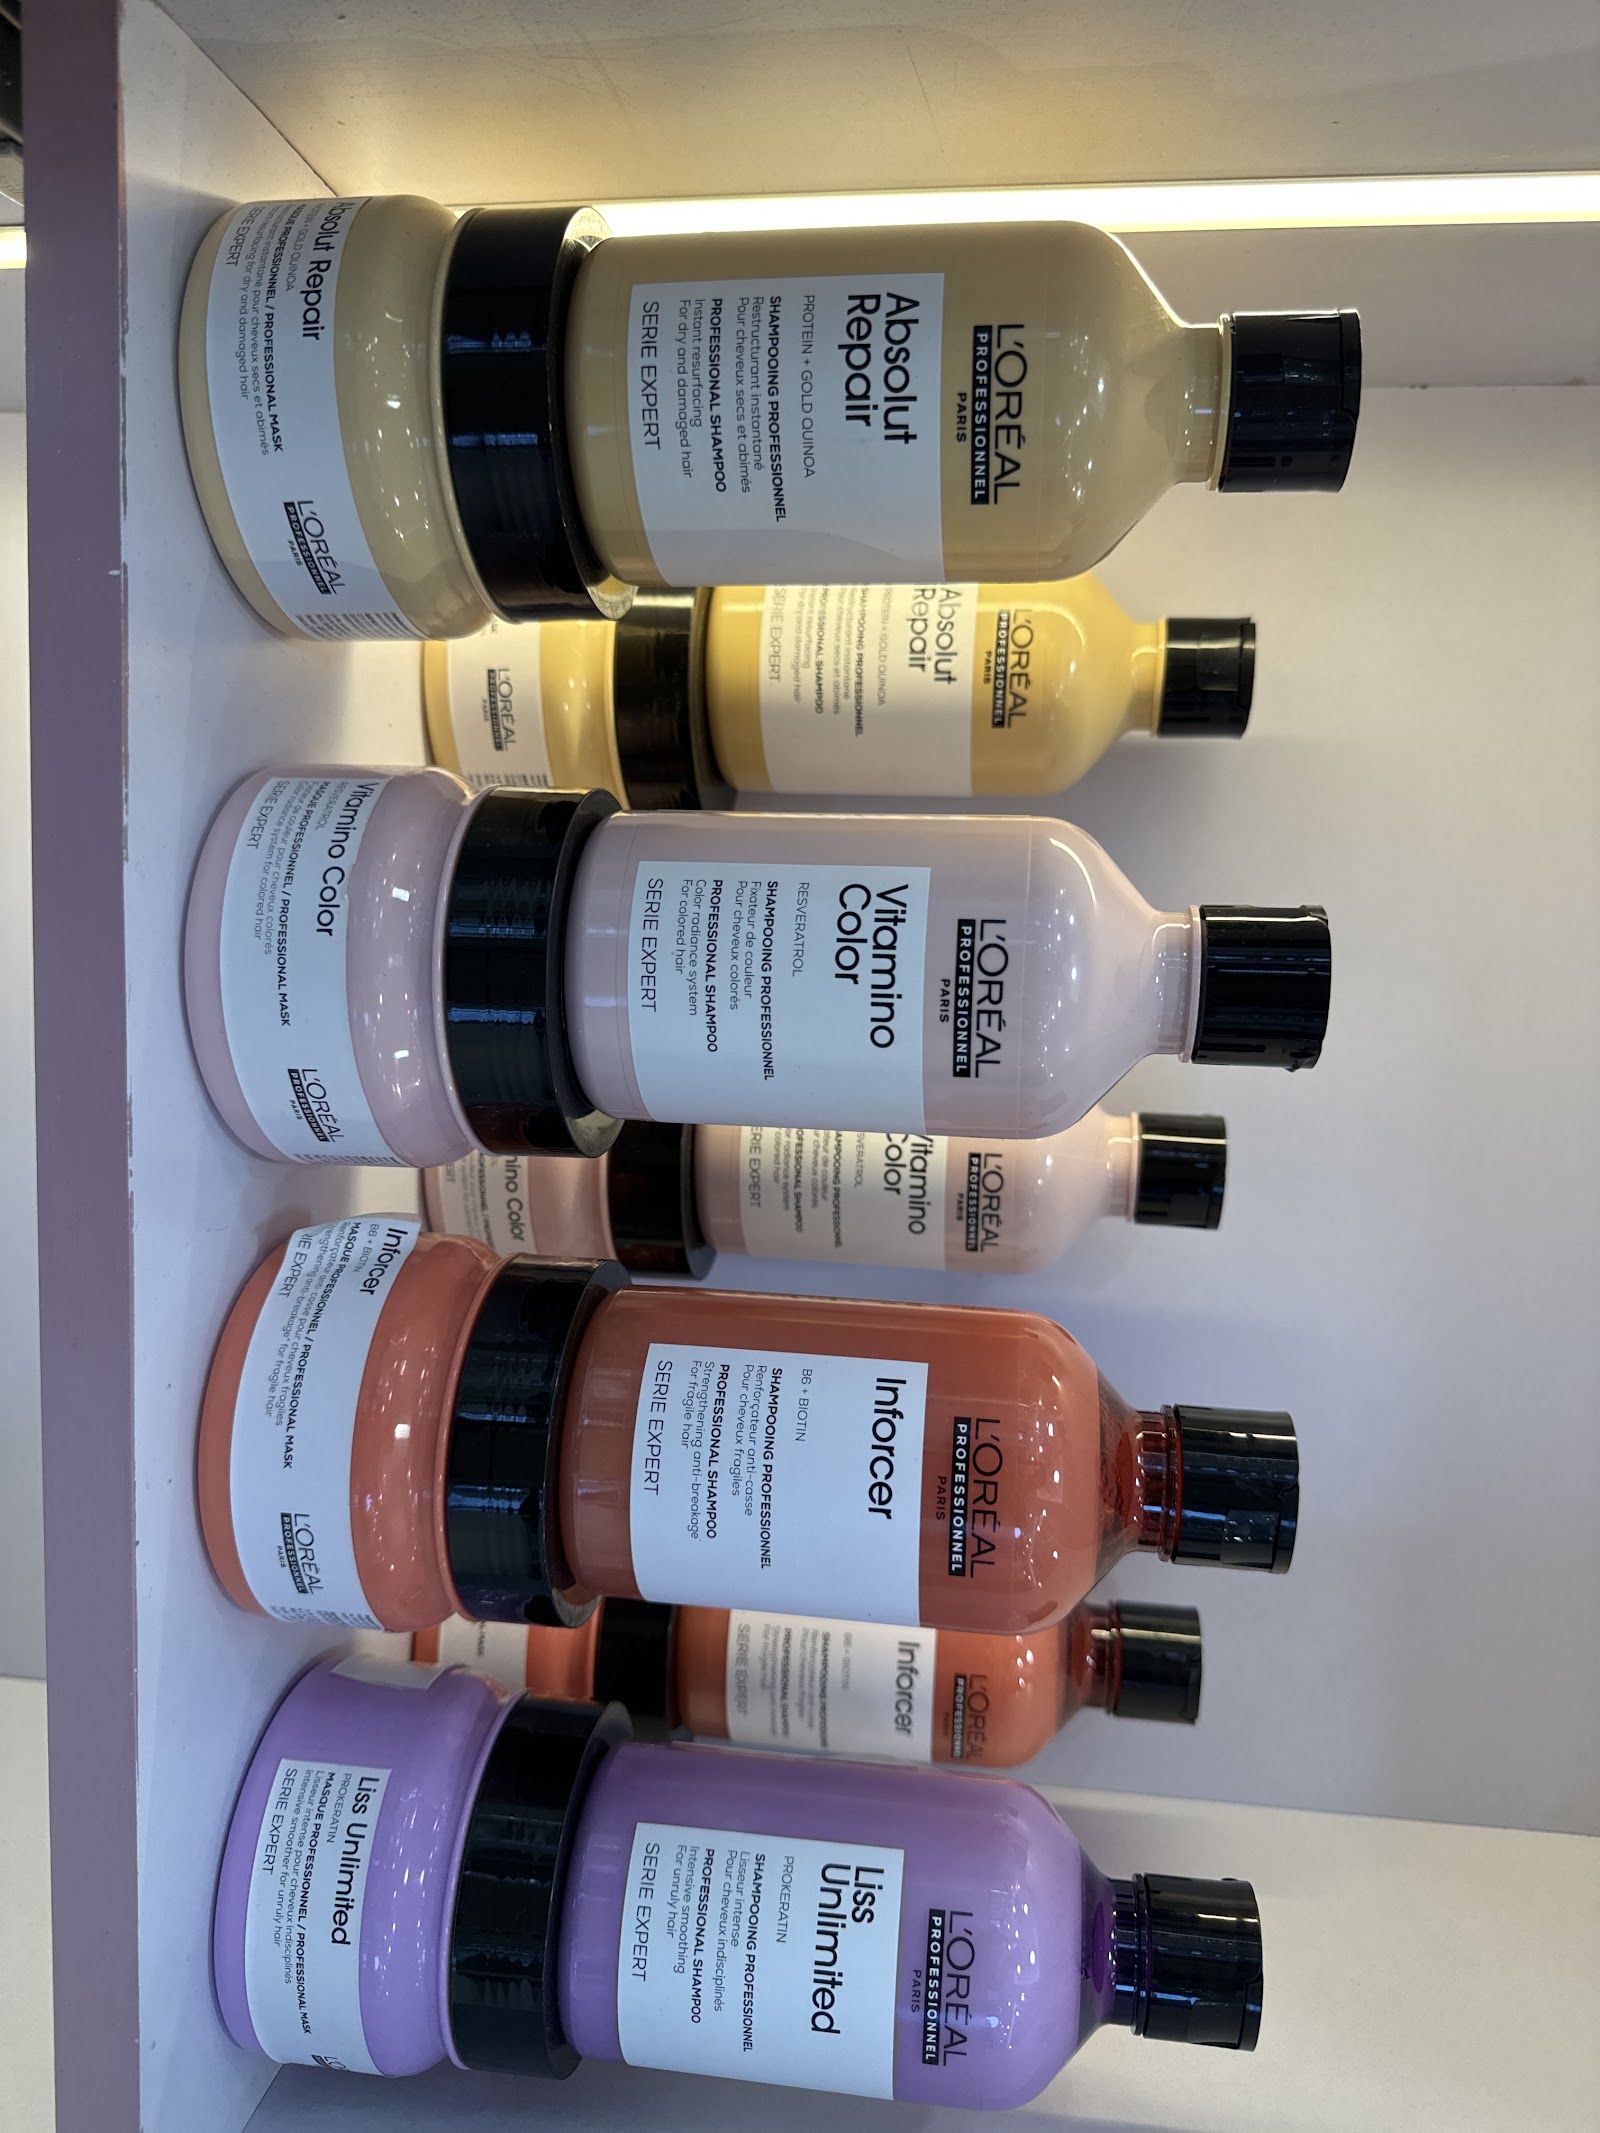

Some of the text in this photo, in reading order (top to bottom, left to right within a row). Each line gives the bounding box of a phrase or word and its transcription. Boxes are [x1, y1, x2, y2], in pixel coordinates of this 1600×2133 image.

[265, 226, 292, 303] PROFESSIONNEL
[300, 202, 355, 340] Absolut Repair
[736, 329, 747, 386] cheveux
[737, 297, 749, 327] Pour
[802, 295, 815, 354] PROTEIN
[264, 313, 276, 412] PROFESSIONAL
[641, 302, 660, 450] SERIE EXPERT
[675, 300, 693, 478] For dry and damaged hair
[689, 299, 705, 427] Instant resurfacing
[709, 299, 726, 492] PROFESSIONAL SHAMPOO
[736, 389, 747, 422] secs
[750, 297, 765, 471] Restructurant instantané
[801, 370, 814, 414] GOLD
[838, 294, 881, 427] Repair
[883, 292, 920, 444] Absolut
[267, 414, 283, 453] MASK
[737, 425, 747, 440] et
[768, 296, 786, 522] SHAMPOOING PROFESSIONNEL
[802, 418, 816, 478] QUINOA
[956, 392, 967, 442] PARIS
[974, 333, 988, 500] PROFESSIONNEL
[994, 324, 1027, 504] L'ORÉAL
[288, 507, 328, 592] PROFESSIONNEL
[288, 541, 303, 566] PARIS
[298, 500, 345, 594] L'ORÉAL
[768, 626, 782, 683] EXPERT
[906, 588, 936, 672] Repair
[934, 588, 962, 684] Absolut
[984, 650, 992, 684] PARIS
[993, 613, 1009, 725] PROFESSIONNEL
[1008, 609, 1034, 728] L'ORÉAL
[281, 809, 314, 889] PROFESSIONNEL
[316, 783, 379, 936] Vitamino Color
[277, 899, 290, 990] PROFESSIONAL
[641, 878, 663, 1012] SERIE EXPERT
[675, 880, 693, 974] For colored hair
[686, 880, 707, 1016] Color radiance system
[705, 880, 723, 1052] PROFESSIONAL SHAMPOO
[730, 881, 748, 1010] Pour cheveux colorés
[744, 881, 762, 998] Fixateur de couleur
[792, 883, 809, 976] RESVERATROL
[835, 884, 871, 984] Color
[870, 884, 908, 1048] Vitamino
[279, 993, 290, 1026] MASK
[761, 881, 778, 1080] SHAMPOOING PROFESSIONNEL
[939, 979, 950, 1022] PARIS
[956, 926, 972, 1072] PROFESSIONNEL
[975, 919, 1009, 1078] L'ORÉAL
[290, 1100, 303, 1119] PARIS
[291, 1072, 327, 1141] PROFESSIONNEL
[302, 1069, 344, 1142] L'ORÉAL
[339, 1222, 362, 1262] MASQUE
[506, 1198, 525, 1242] Color
[956, 1193, 964, 1221] PARIS
[967, 1157, 979, 1249] PROFESSIONNEL
[981, 1153, 1002, 1252] L'ORÉAL
[306, 1264, 346, 1335] PROFESSIONNEL
[360, 1228, 408, 1295] Inforcer
[286, 1344, 312, 1432] PROFESSIONAL
[681, 1361, 702, 1448] For fragile hair
[691, 1361, 715, 1447] Strengthening
[795, 1398, 809, 1441] BIOTIN
[801, 1369, 812, 1384] B6
[283, 1435, 294, 1468] MASK
[644, 1361, 672, 1495] SERIE EXPERT
[706, 1364, 730, 1538] PROFESSIONAL SHAMPOO
[729, 1364, 754, 1496] Pour cheveux fragiles
[745, 1365, 767, 1516] Renforçateur anti-casse
[760, 1368, 782, 1569] SHAMPOOING PROFESSIONNEL
[868, 1378, 906, 1519] Inforcer
[936, 1476, 947, 1520] PARIS
[952, 1423, 968, 1572] PROFESSIONNEL
[970, 1418, 1003, 1578] L'ORÉAL
[277, 1546, 287, 1567] PARIS
[282, 1516, 305, 1592] PROFESSIONNEL
[294, 1513, 323, 1594] L'ORÉAL
[894, 1641, 920, 1735] Inforcer
[262, 1768, 297, 1875] SERIE EXPERT
[314, 1771, 335, 1820] MASQUE
[327, 1774, 352, 1843] PROKERATIN
[298, 1822, 321, 1922] PROFESSIONNEL
[330, 1777, 379, 1945] Liss Unlimited
[667, 1845, 687, 1938] For unruly hair
[731, 1851, 750, 1947] Lisseur intense
[776, 1856, 794, 1943] PROKERATIN
[851, 1866, 884, 1923] Liss
[632, 1843, 660, 1981] SERIE EXPERT
[673, 1846, 700, 1974] Intensive smoothing
[691, 1849, 714, 2023] PROFESSIONAL SHAMPOO
[712, 1850, 738, 2011] Pour cheveux indisciplinés
[743, 1853, 765, 2052] SHAMPOOING PROFESSIONNEL
[811, 1864, 851, 2034] Unlimited
[296, 1933, 306, 2010] PROFESSIONAL
[911, 1969, 921, 2013] PARIS
[925, 1916, 941, 2060] PROFESSIONNEL
[943, 1911, 975, 2066] L'ORÉAL
[300, 2012, 311, 2034] MASK
